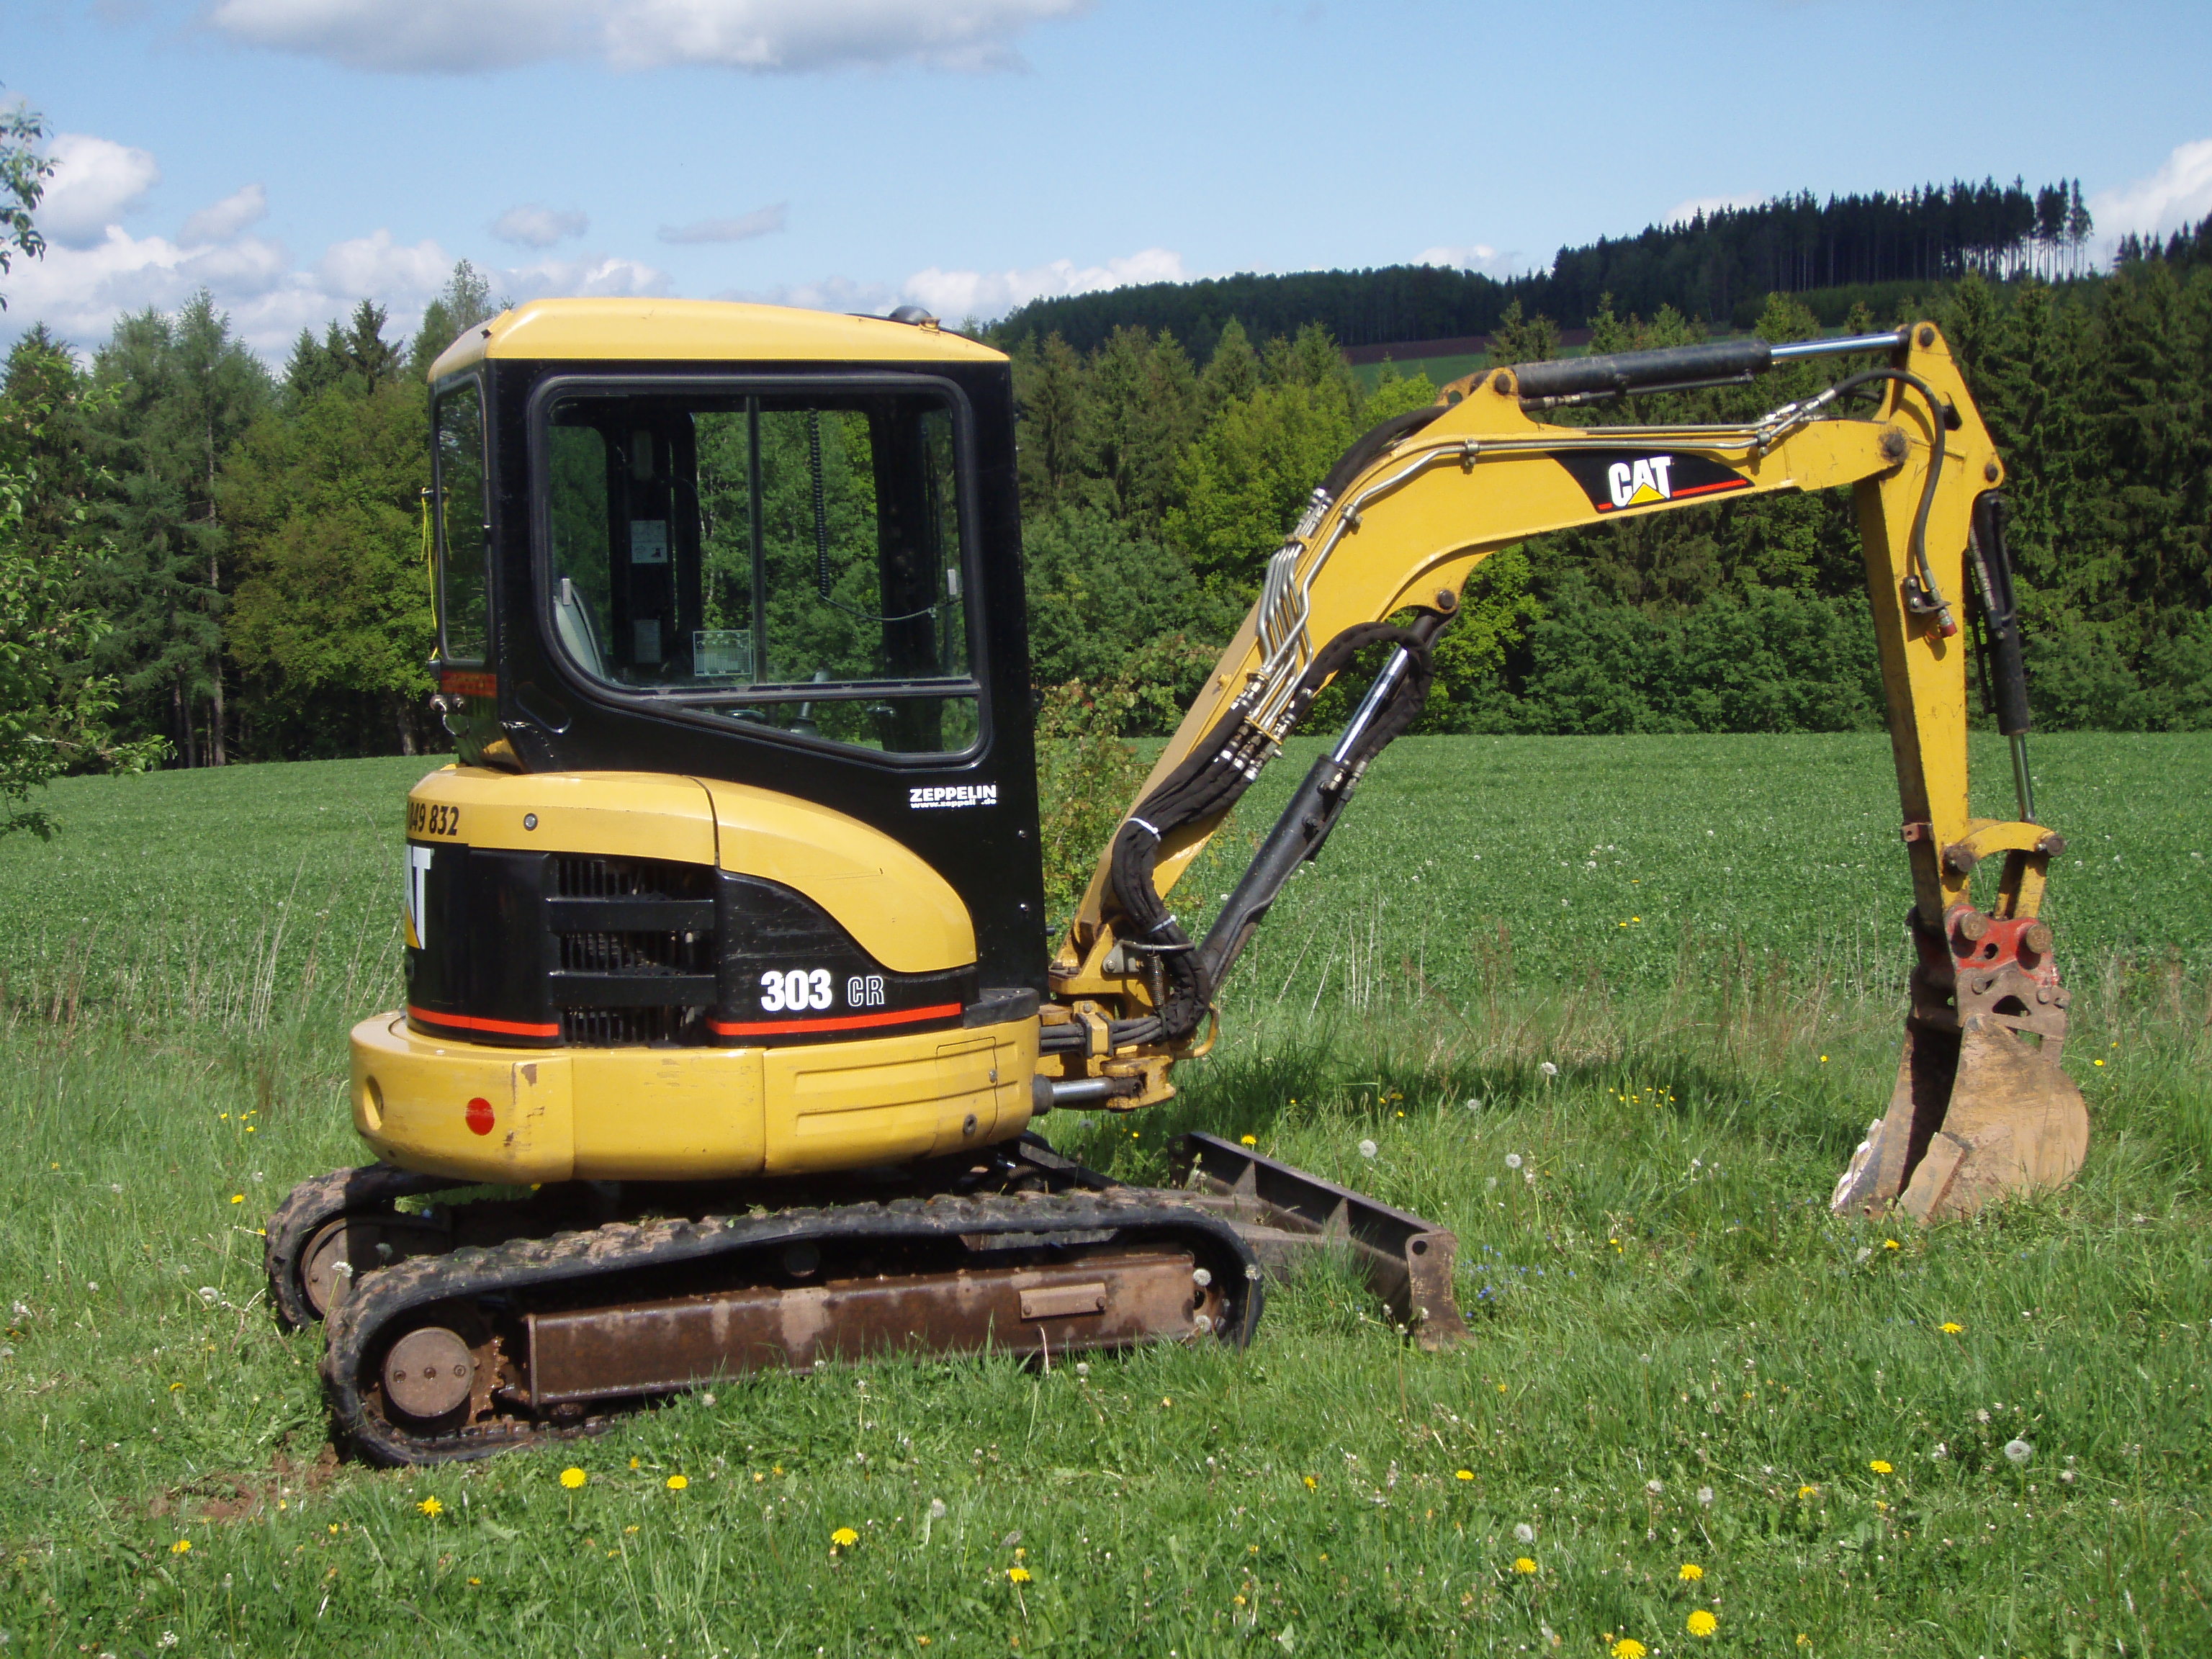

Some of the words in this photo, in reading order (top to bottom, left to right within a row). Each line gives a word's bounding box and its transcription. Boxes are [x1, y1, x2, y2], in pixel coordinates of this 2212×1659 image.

[1608, 455, 1671, 507] CAT
[909, 785, 997, 802] ZEPPELIN
[910, 798, 997, 809] www.zeppeli.de
[429, 804, 459, 836] 832
[760, 969, 832, 1012] 303
[848, 976, 885, 1007] CR
